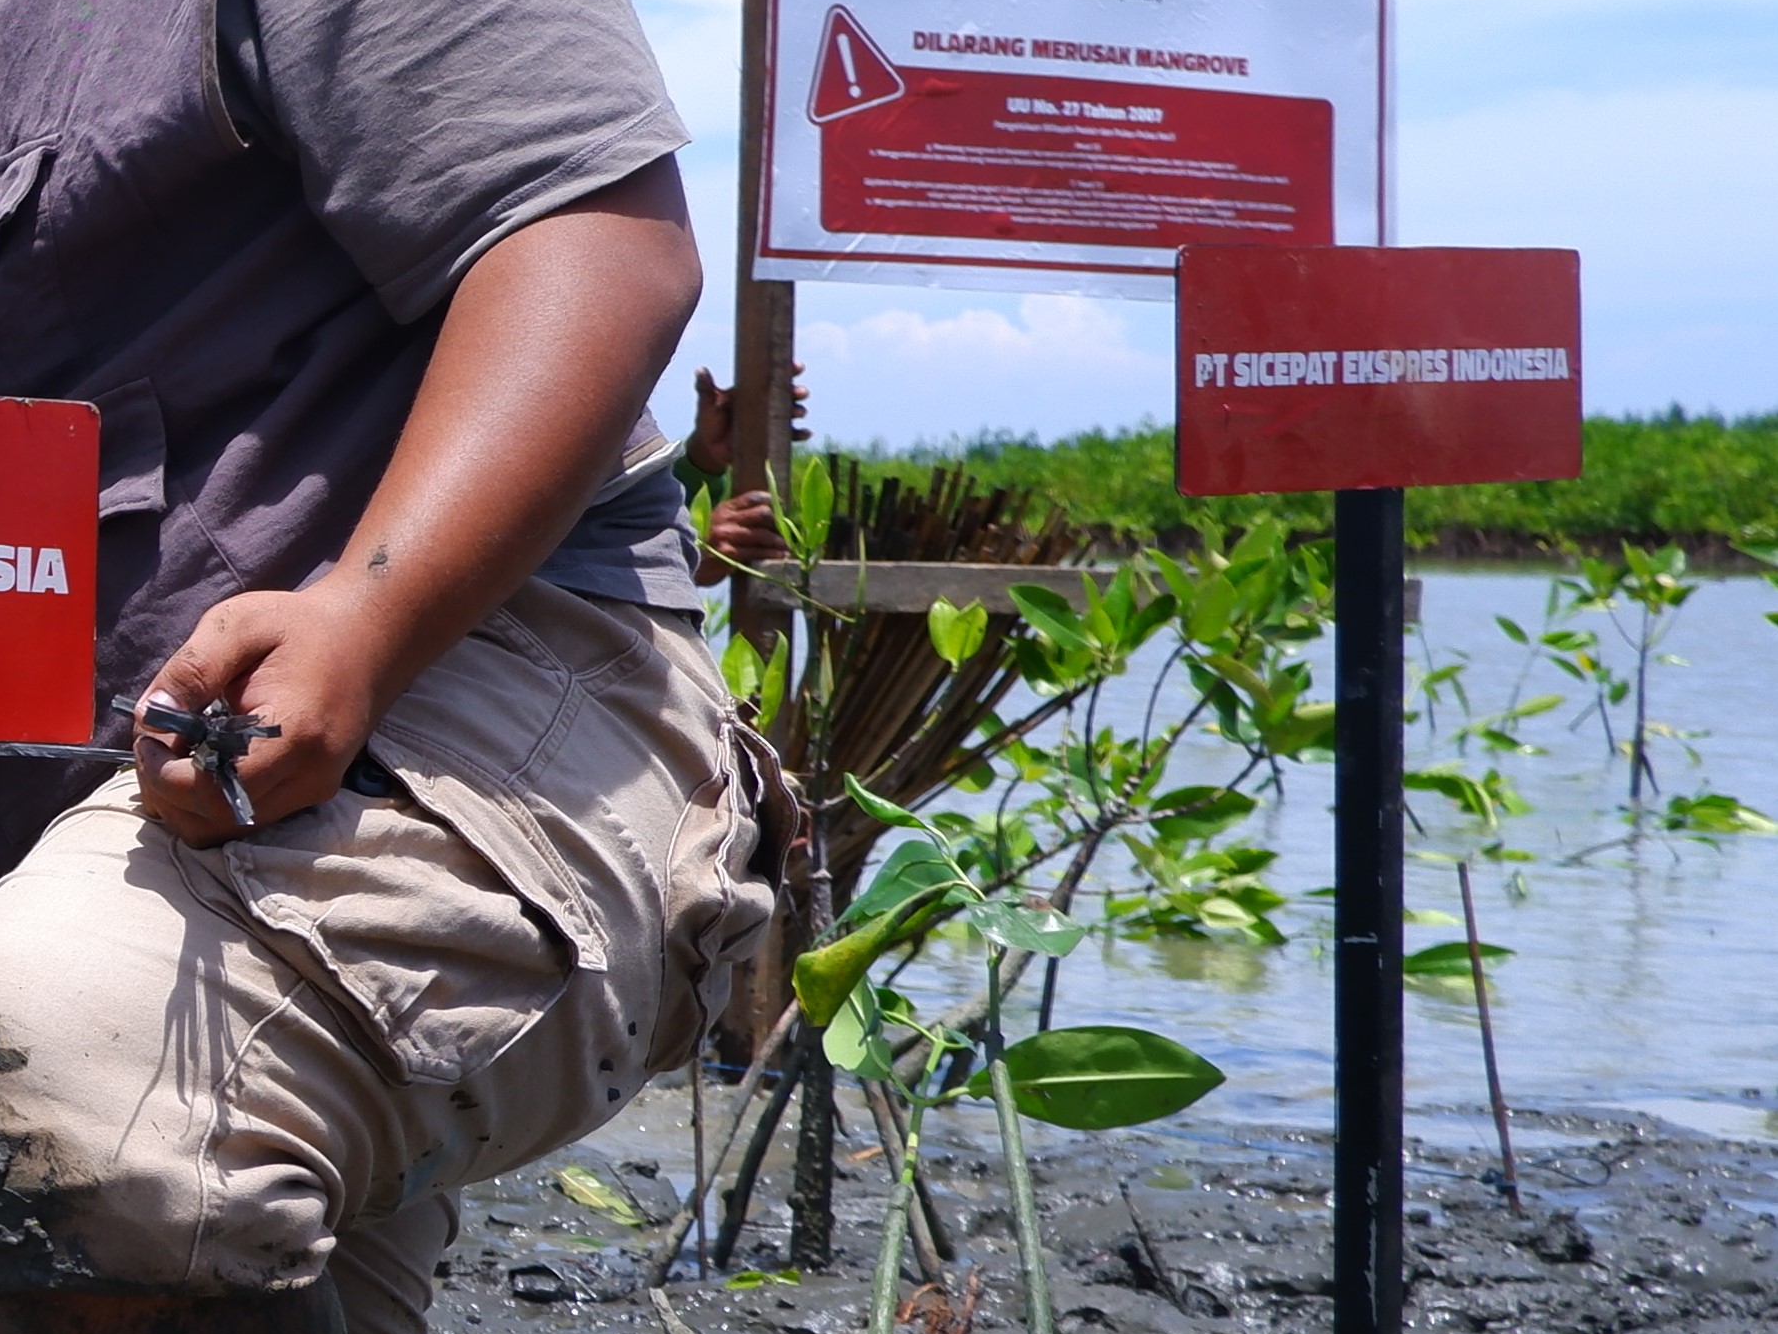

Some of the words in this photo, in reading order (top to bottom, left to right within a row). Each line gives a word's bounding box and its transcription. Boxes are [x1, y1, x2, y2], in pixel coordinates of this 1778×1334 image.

[913, 31, 1025, 58] DILARANG
[1031, 39, 1132, 67] MERUSAK
[1135, 48, 1250, 77] MANGROVE
[1006, 96, 1031, 115] UU
[1031, 98, 1061, 116] No.
[1082, 101, 1127, 121] Tahun
[1194, 353, 1226, 387] PT
[1233, 351, 1337, 386] SICEPAT
[1342, 348, 1448, 384] EKSPRES
[1452, 347, 1569, 382] INDONESIA
